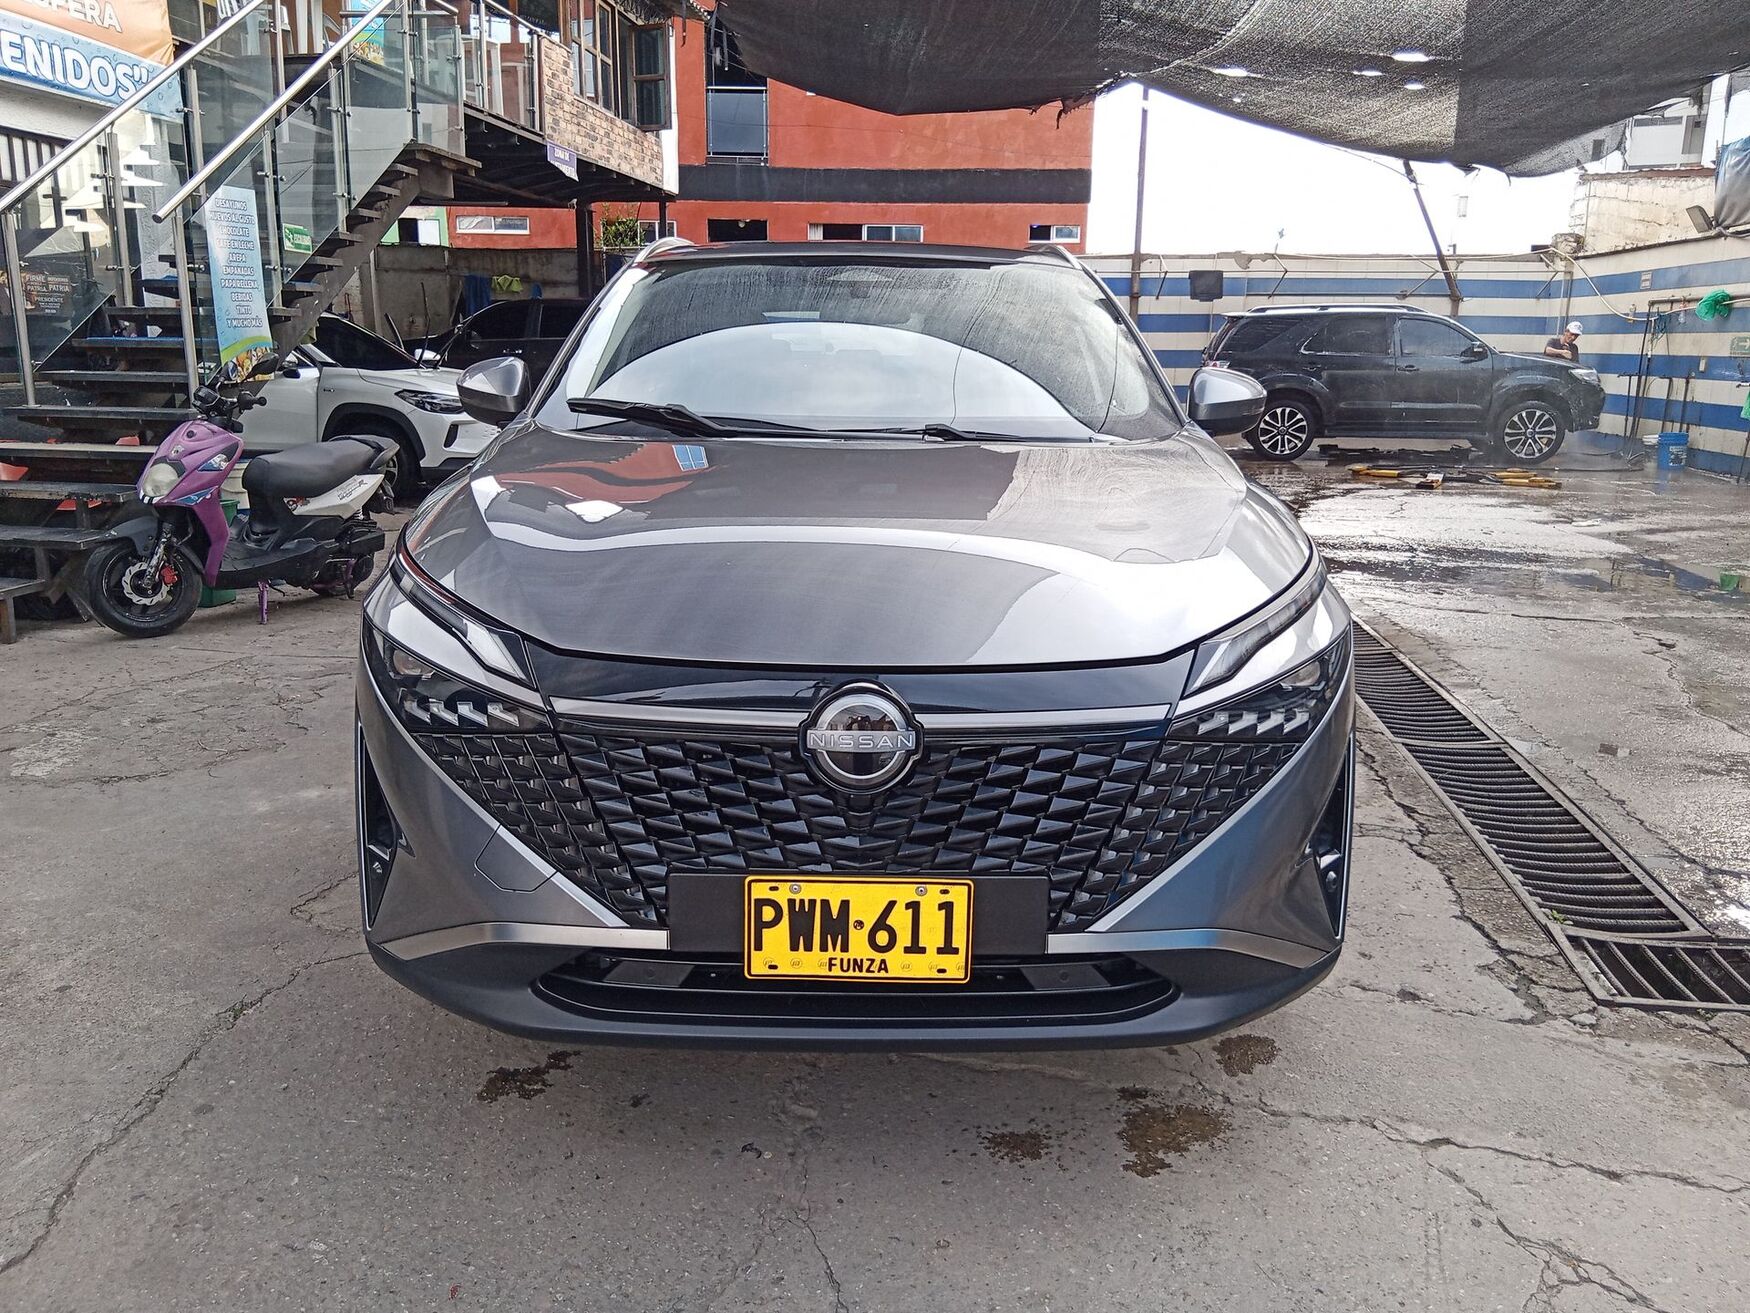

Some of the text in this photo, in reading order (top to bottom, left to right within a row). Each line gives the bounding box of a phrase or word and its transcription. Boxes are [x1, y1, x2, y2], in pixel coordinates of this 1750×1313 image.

[48, 284, 70, 292] PATRIA
[236, 305, 252, 315] TINTO
[809, 732, 914, 748] NISSAN
[827, 957, 889, 974] FUNZA
